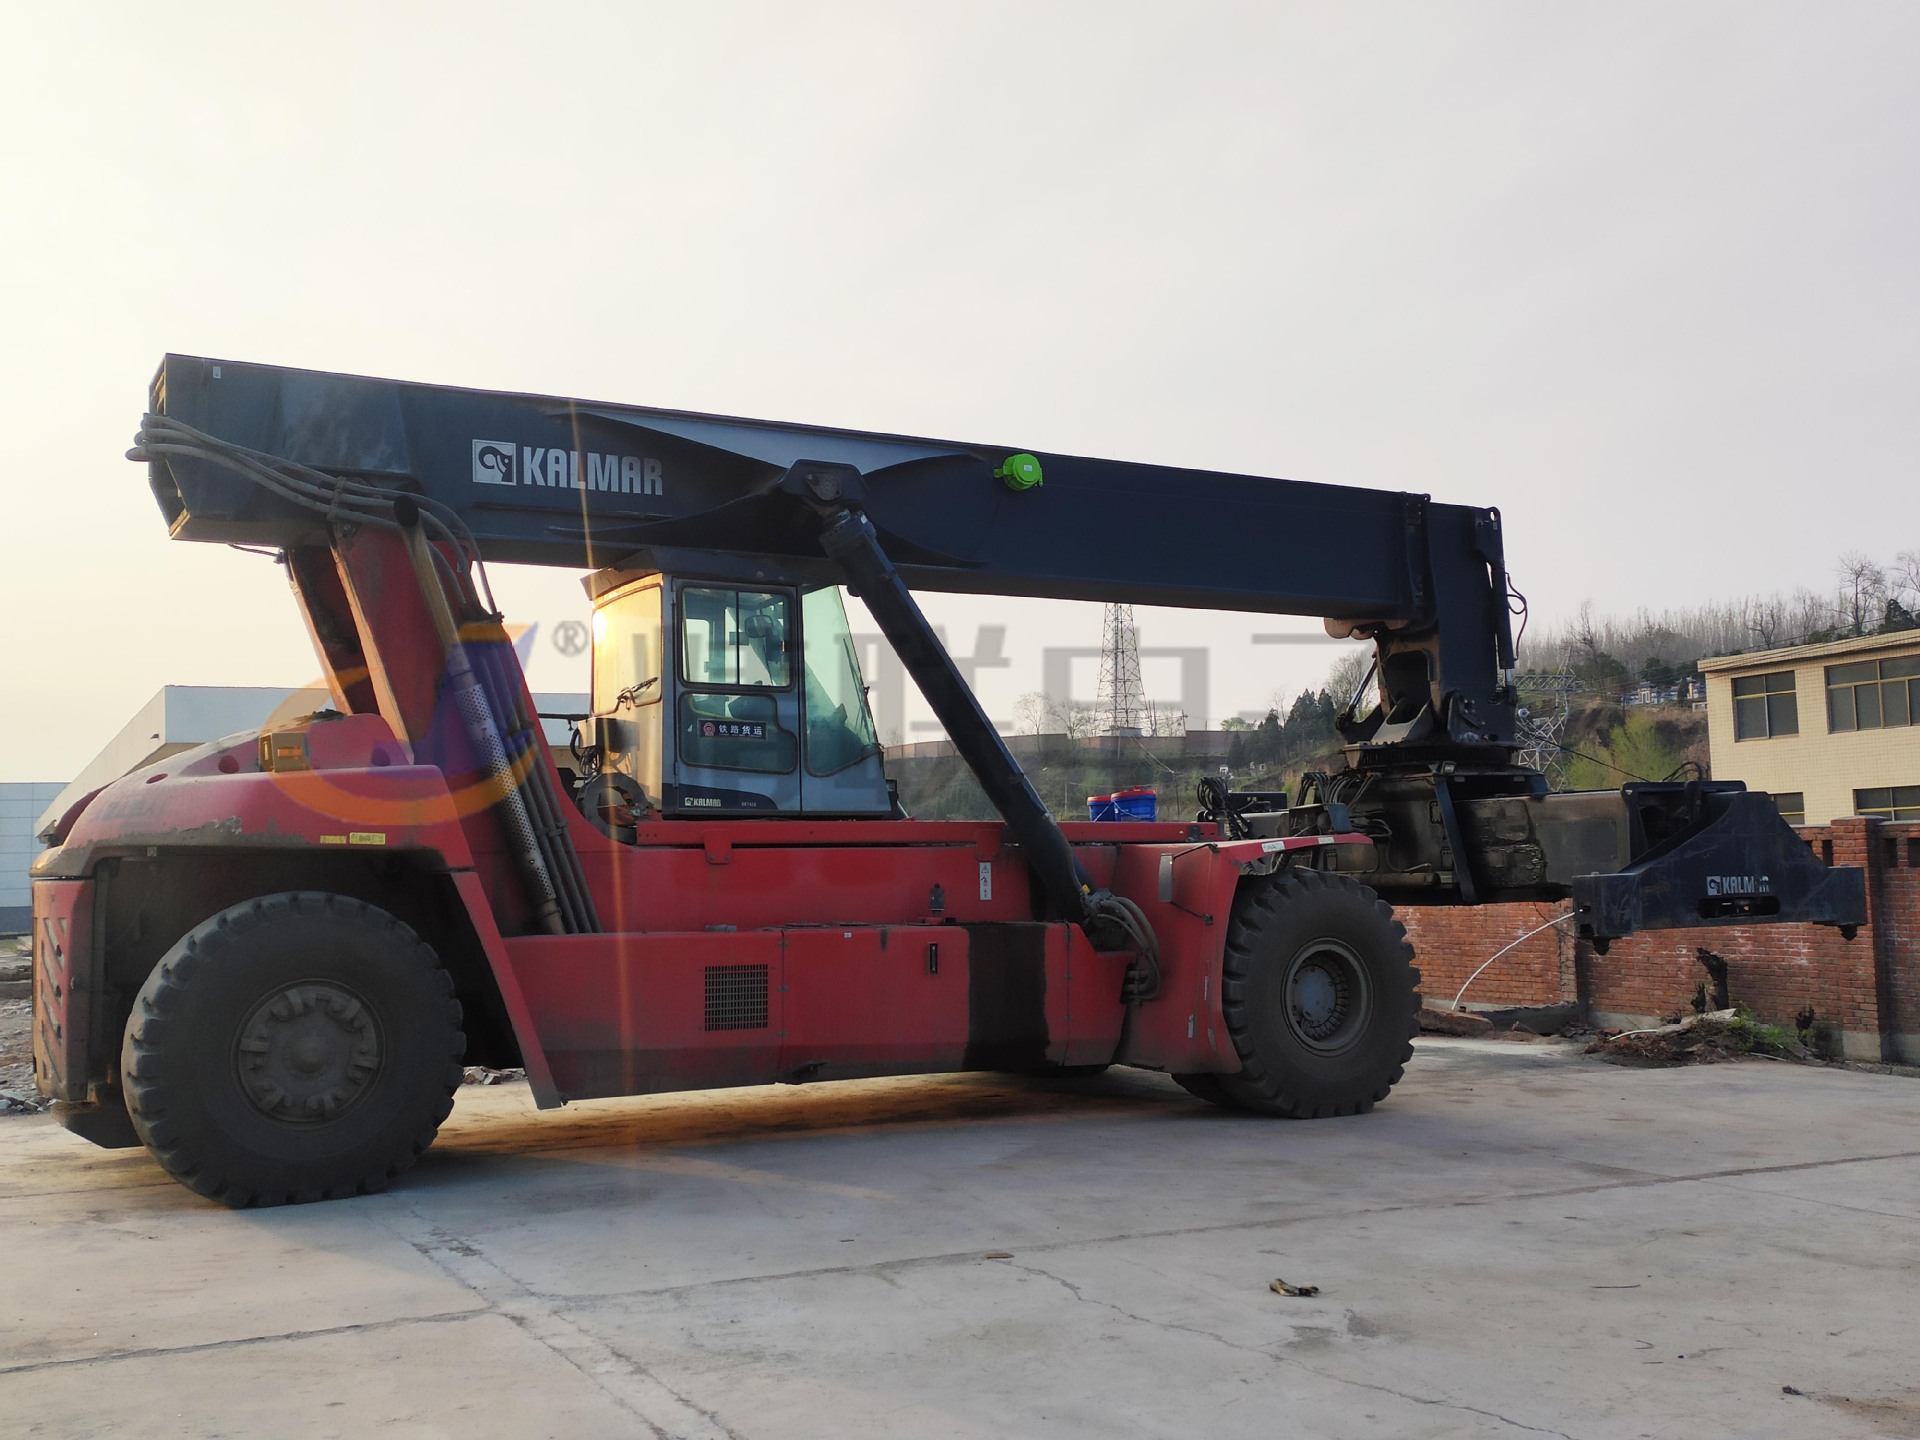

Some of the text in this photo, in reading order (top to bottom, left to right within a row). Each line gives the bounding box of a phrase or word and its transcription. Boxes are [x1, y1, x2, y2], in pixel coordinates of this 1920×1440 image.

[523, 446, 663, 496] KALMAR
[719, 724, 762, 734] 铁路货运
[693, 798, 721, 807] KALMAR
